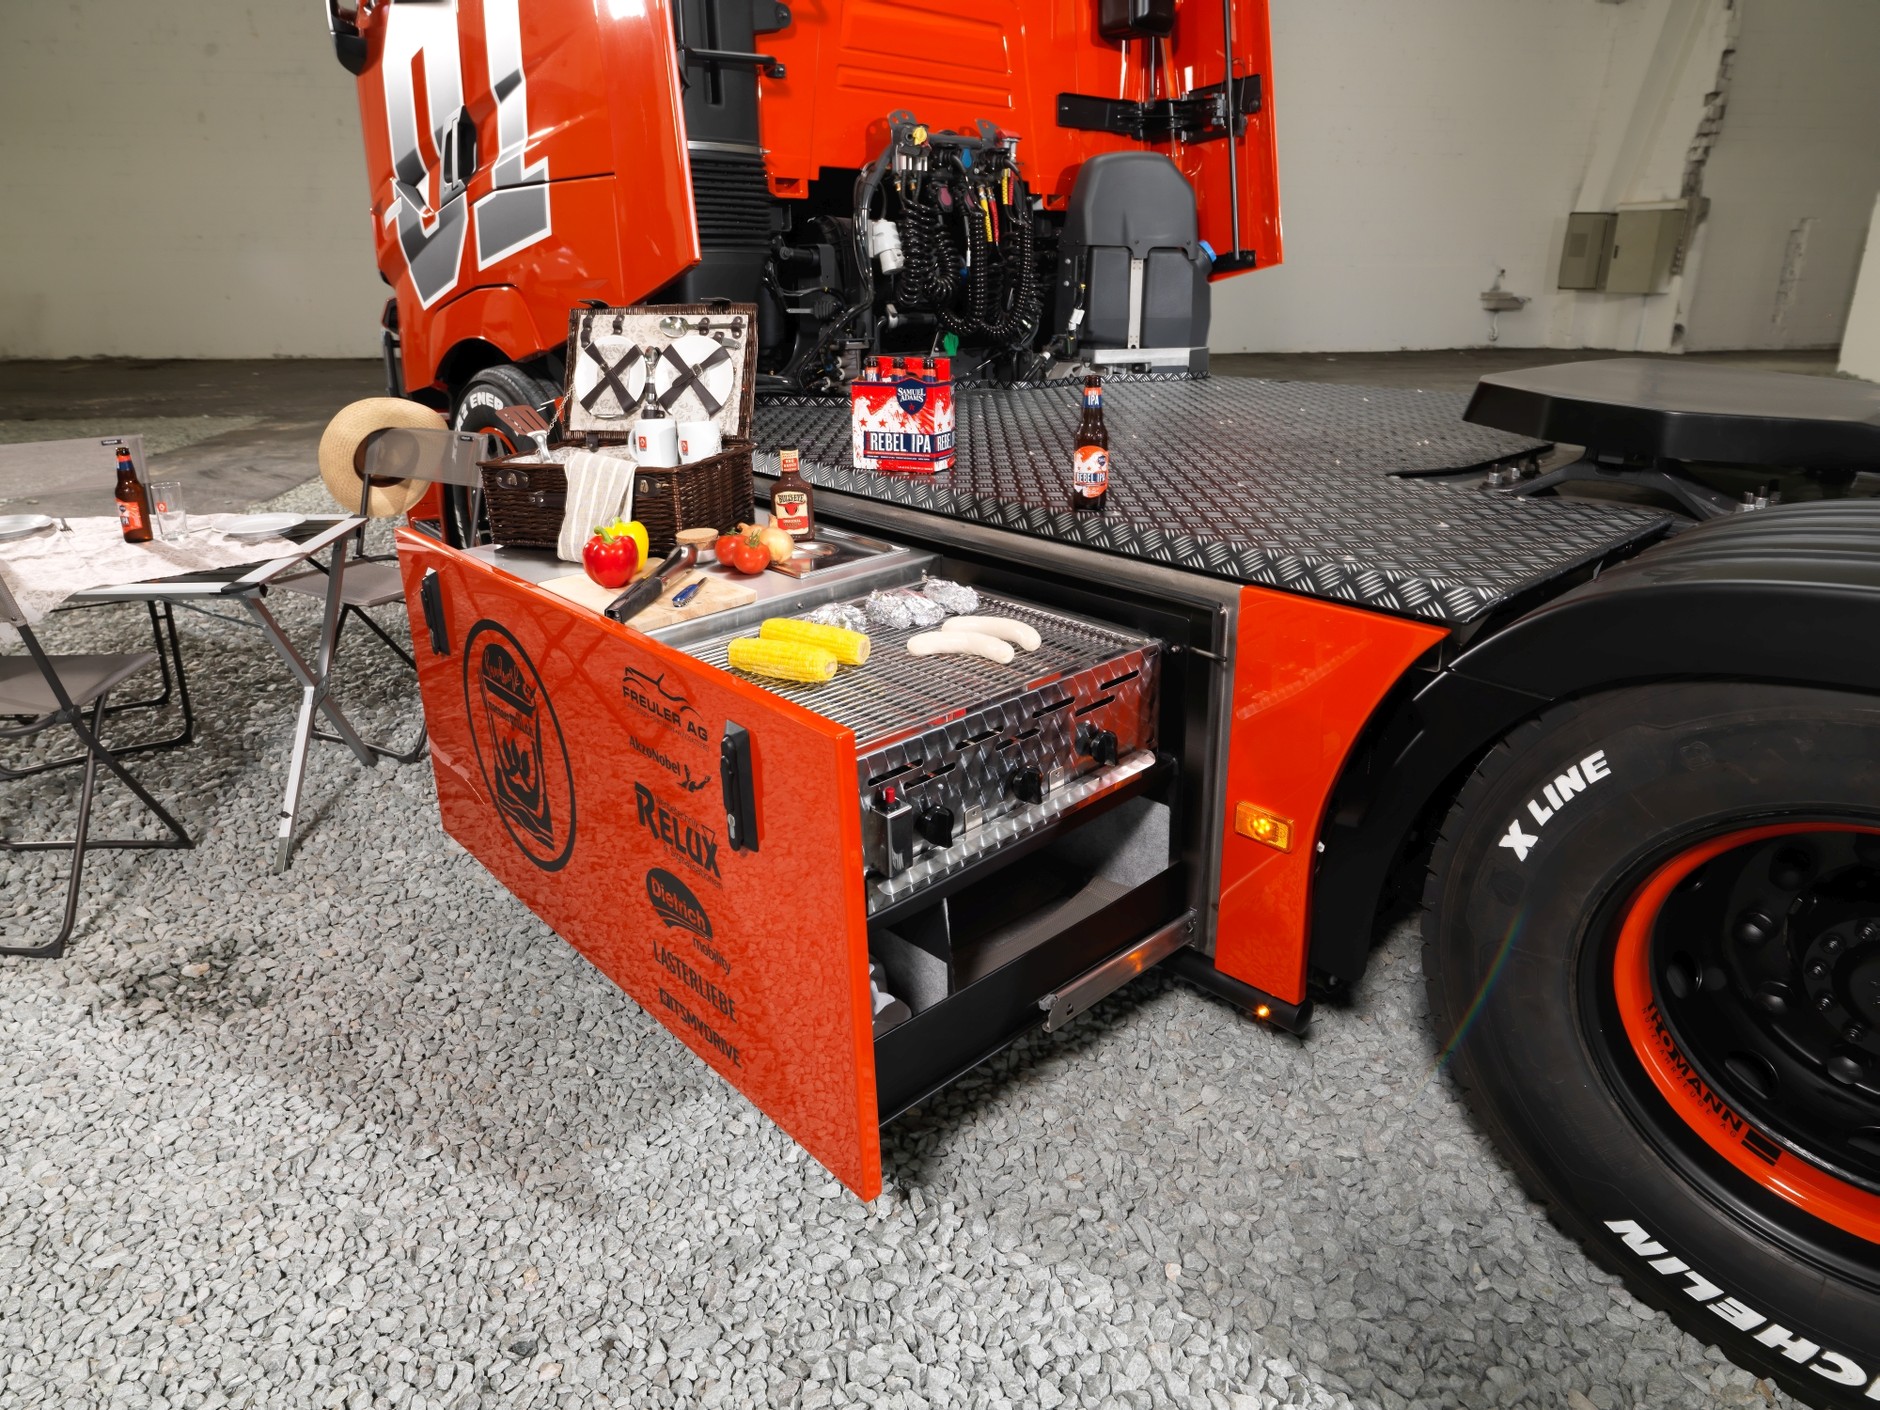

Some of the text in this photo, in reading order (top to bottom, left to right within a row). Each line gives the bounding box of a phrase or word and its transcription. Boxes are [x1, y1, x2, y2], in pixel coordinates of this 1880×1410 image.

[897, 387, 926, 397] SAMUEL
[900, 394, 924, 403] ADAMS
[1087, 395, 1099, 406] IPA
[870, 432, 908, 452] REBEL
[910, 434, 932, 453] IPA
[1076, 472, 1095, 482] REBEL
[622, 685, 682, 727] FREULER
[686, 720, 708, 742] AG
[629, 735, 681, 776] AkzoNobel
[1498, 749, 1612, 862] X LINE
[650, 875, 707, 933] Dietrich
[692, 935, 731, 976] mobility
[653, 940, 738, 1024] LASTERLIEBE
[1642, 1007, 1737, 1137] NUTZFAHRZEUGE AG
[1648, 1000, 1743, 1132] THOMANN
